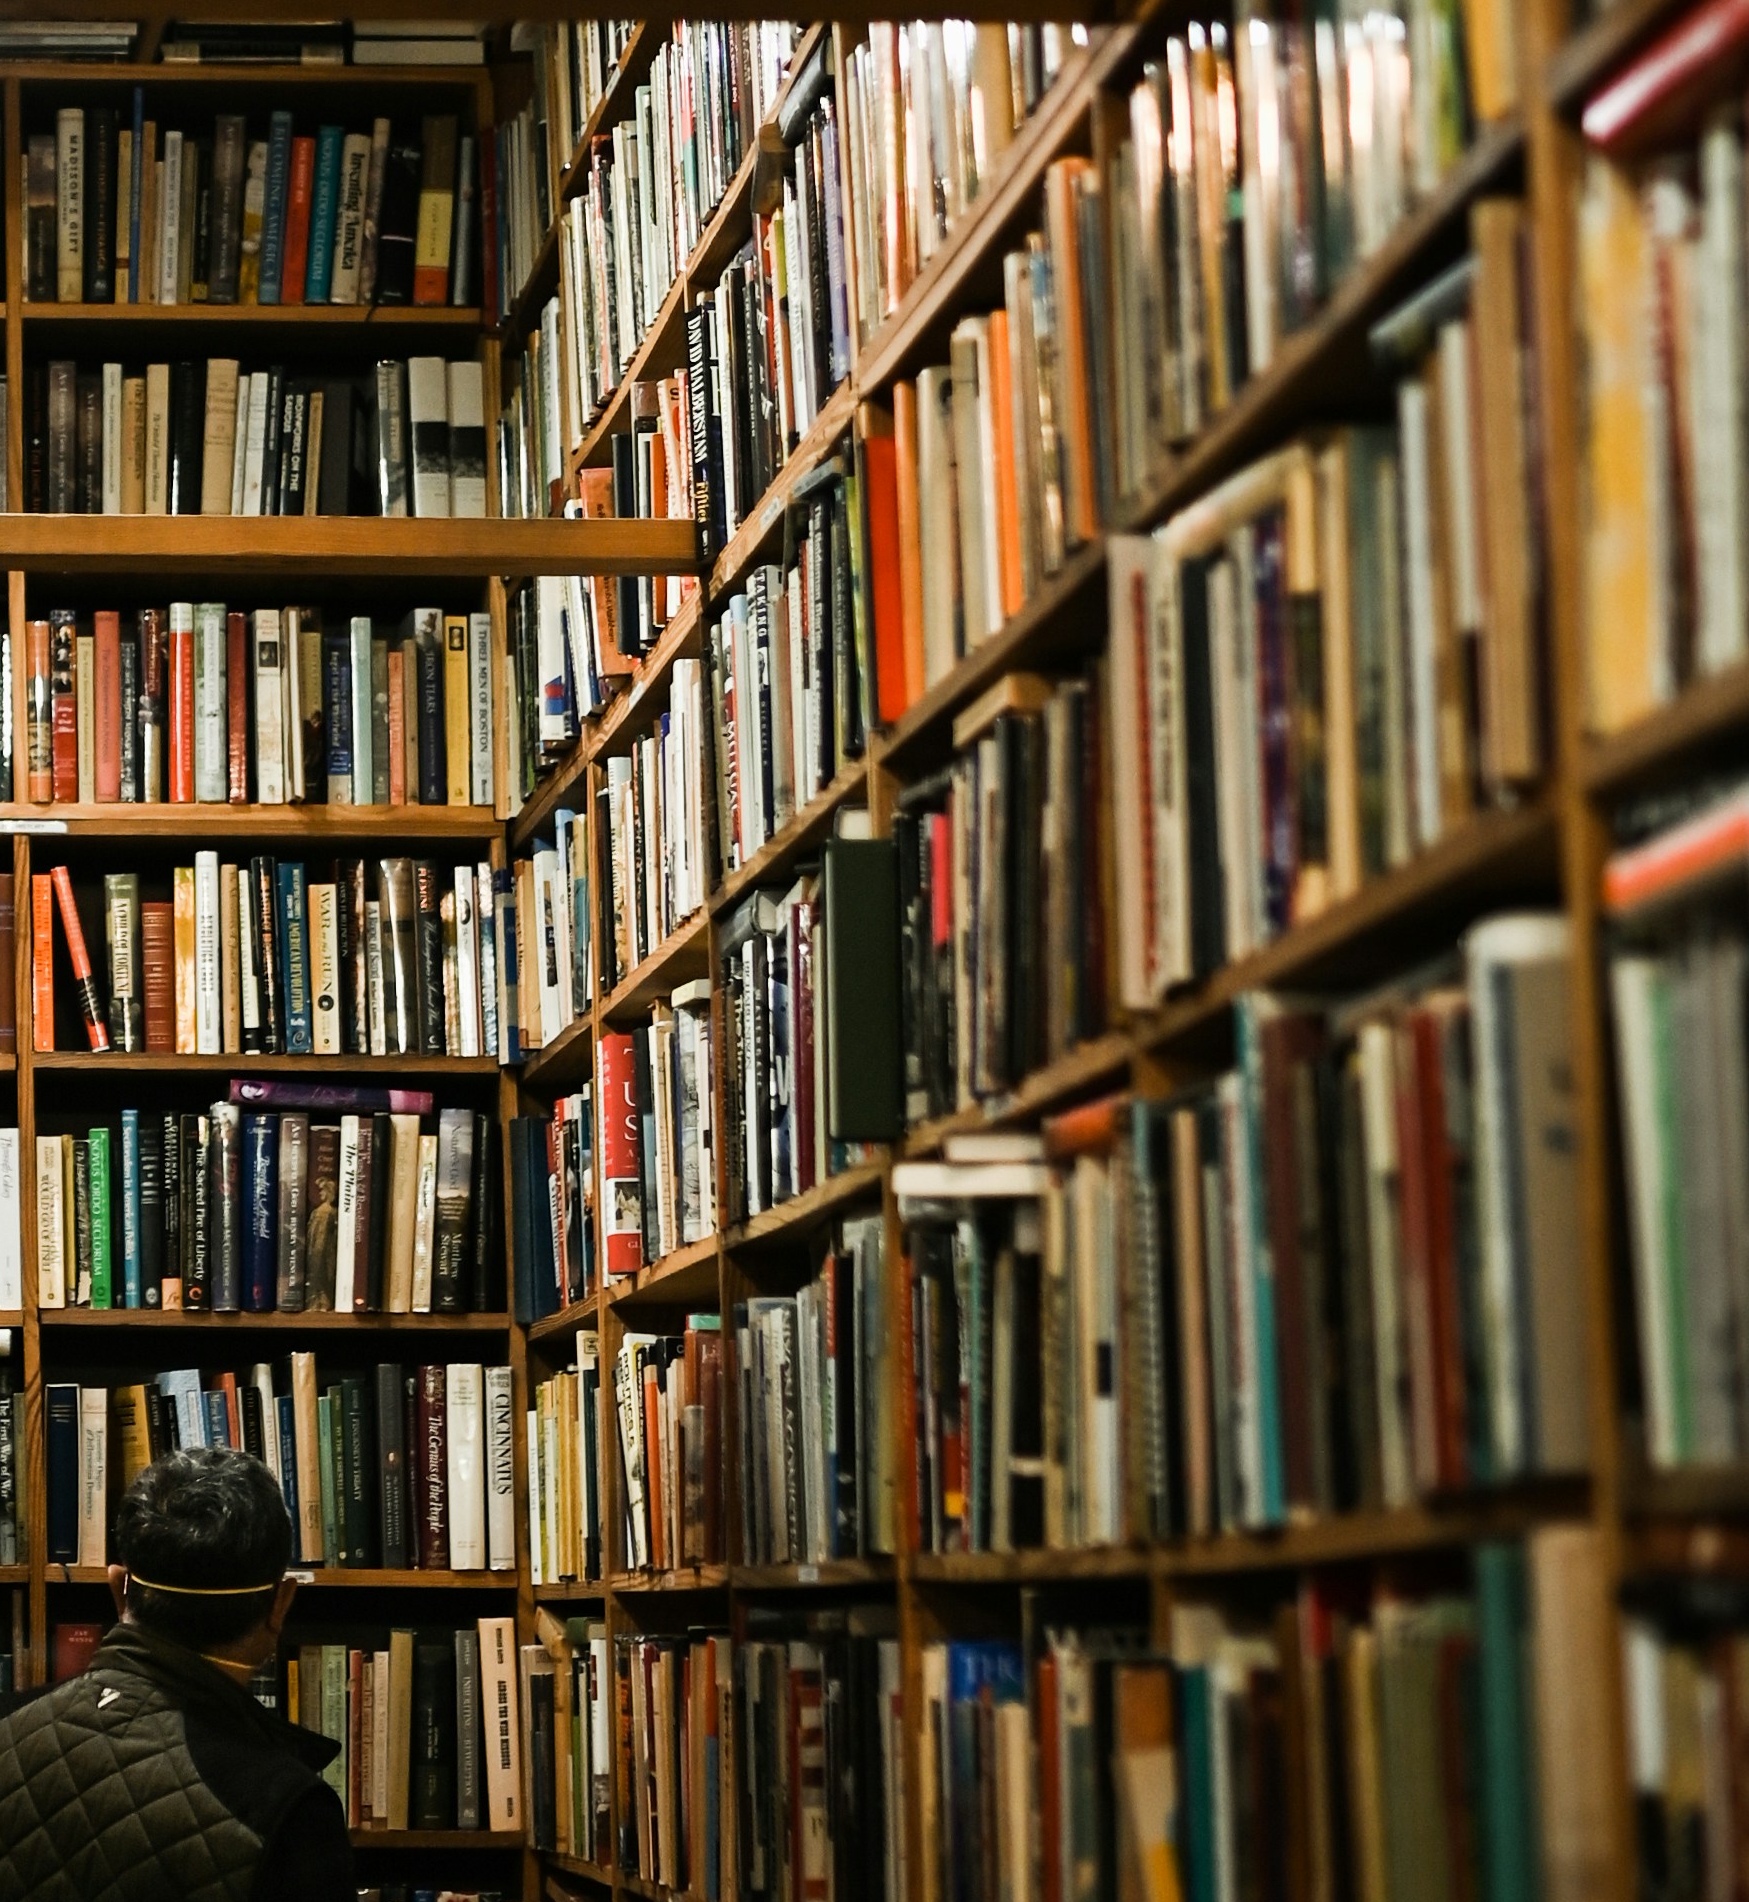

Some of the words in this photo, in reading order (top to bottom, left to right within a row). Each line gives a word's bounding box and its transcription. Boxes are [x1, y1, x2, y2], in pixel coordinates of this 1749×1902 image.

[69, 135, 78, 214] MADISON'S
[269, 127, 286, 207] BECOMING
[319, 137, 334, 176] NOVUS
[317, 181, 330, 215] ORDO
[346, 153, 365, 212] Inventing
[69, 221, 78, 253] GIFT
[264, 214, 280, 277] AMERICA
[311, 218, 330, 280] SECLORUM
[342, 218, 359, 270] America
[687, 315, 704, 362] DAVID
[292, 395, 304, 453] IRONWORKS
[689, 362, 708, 464] HALBERSTAM
[291, 456, 300, 470] ON
[289, 474, 299, 492] THE
[696, 481, 708, 524] Fifties
[813, 504, 823, 528] The
[814, 531, 823, 598] Haldeman
[755, 574, 768, 638] TAKING
[814, 603, 824, 651] Diaries
[479, 630, 487, 663] THREE
[425, 652, 436, 681] IRON
[479, 667, 487, 688] MEN
[425, 684, 436, 713] TEARS
[479, 691, 487, 704] OF
[479, 709, 488, 753] BOSTON
[418, 867, 428, 913] FLEMING
[321, 891, 331, 928] WAR
[368, 908, 379, 916] A
[289, 922, 302, 963] AMERICAN
[368, 918, 379, 940] Rope
[370, 944, 380, 952] of
[116, 953, 129, 994] FORTUNE
[322, 956, 332, 994] RUN
[370, 954, 380, 979] Sand
[290, 963, 303, 1015] REVOLUTION
[743, 1021, 752, 1071] NIXON
[753, 988, 763, 1089] WATERGATE
[91, 1139, 100, 1177] NOVUS
[122, 1126, 133, 1178] Sectionalism
[163, 1115, 172, 1190] REVOLUTIONARY
[195, 1148, 205, 1166] The
[346, 1144, 356, 1166] The
[358, 1128, 366, 1150] Rum
[451, 1125, 461, 1165] Nature's
[124, 1179, 132, 1188] in
[258, 1156, 270, 1196] Benedict
[357, 1152, 366, 1180] Punch
[40, 1174, 49, 1211] WOULD
[92, 1181, 100, 1215] ORDO
[195, 1169, 205, 1205] Sacred
[344, 1170, 355, 1214] Plains
[41, 1213, 50, 1228] GO
[124, 1191, 133, 1229] American
[195, 1209, 205, 1233] Fire
[258, 1198, 270, 1240] Arnold
[355, 1196, 365, 1243] Revolution
[41, 1230, 50, 1242] OF
[93, 1219, 102, 1276] SECLORUM
[124, 1231, 134, 1260] Politics
[439, 1234, 450, 1276] Stewart
[41, 1245, 51, 1272] ITSELF
[194, 1244, 205, 1281] Liberty
[451, 1233, 463, 1280] Matthew
[782, 1310, 794, 1398] NIXON
[622, 1352, 634, 1423] POLITICS
[0, 1398, 11, 1416] The
[429, 1415, 442, 1435] The
[0, 1419, 11, 1441] First
[351, 1418, 360, 1467] PINCKNEY'S
[494, 1394, 512, 1495] CINCINNATUS
[0, 1444, 11, 1463] Way
[0, 1466, 11, 1476] of
[429, 1435, 443, 1473] Genius
[0, 1479, 12, 1498] War
[353, 1470, 362, 1502] TREATY
[426, 1474, 444, 1484] of
[429, 1484, 444, 1501] the
[86, 1482, 94, 1520] Democracy
[426, 1502, 445, 1534] People
[463, 1739, 473, 1797] REVOLUTION
